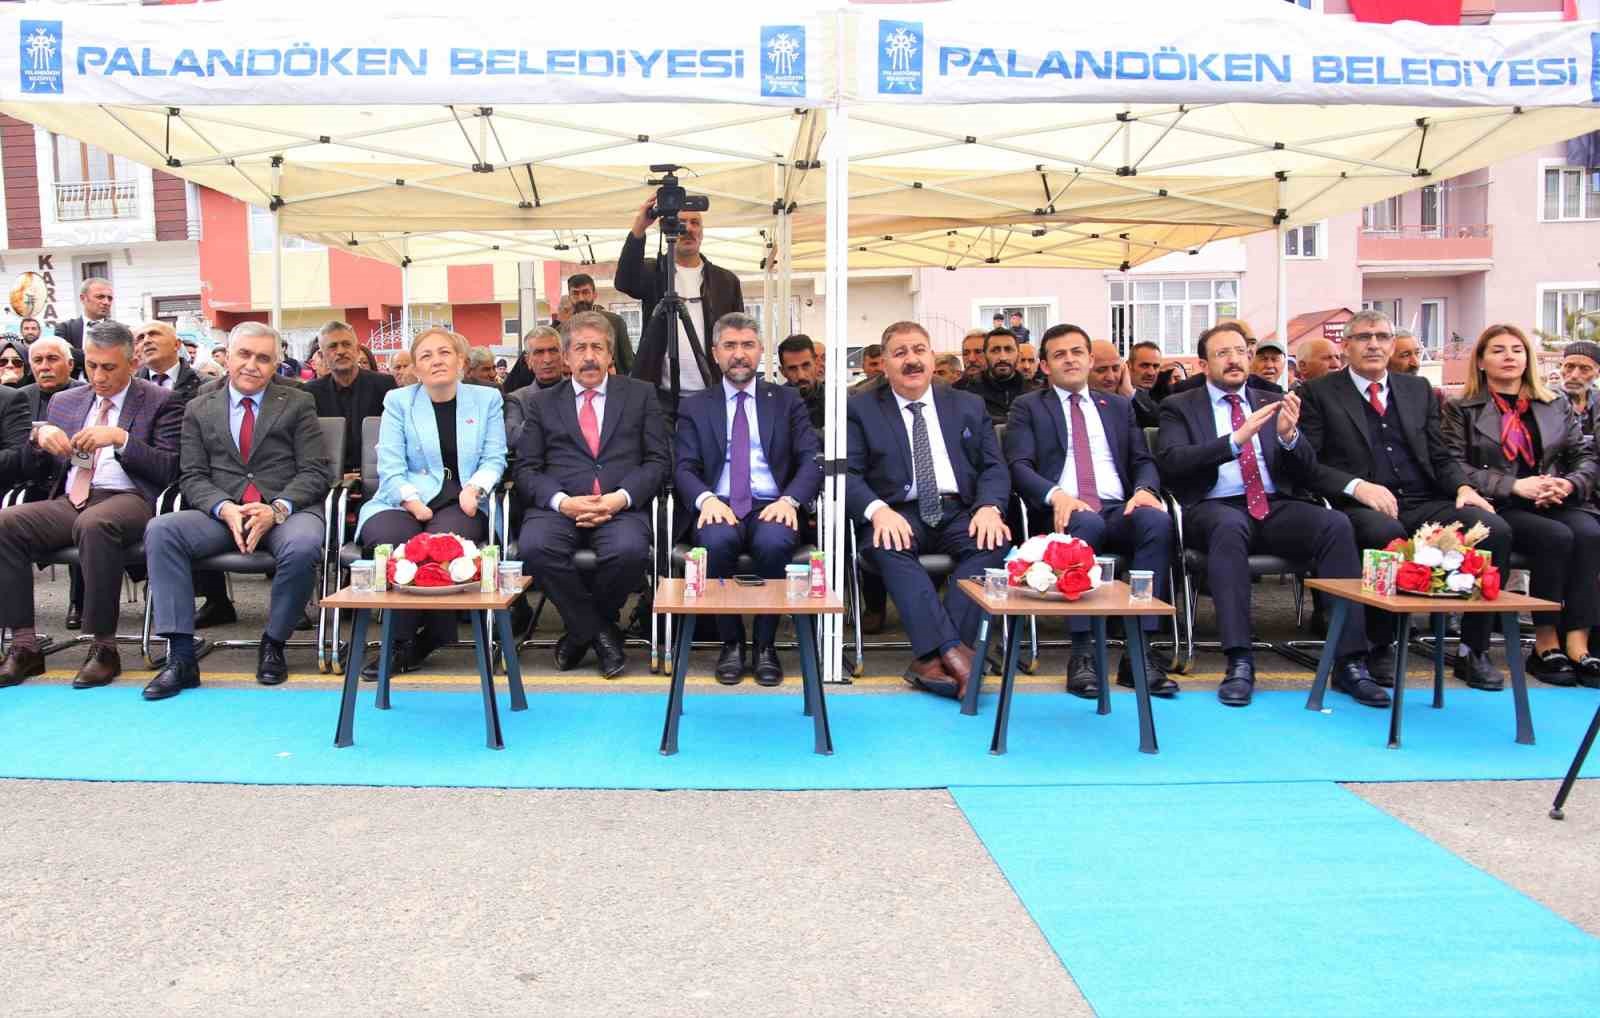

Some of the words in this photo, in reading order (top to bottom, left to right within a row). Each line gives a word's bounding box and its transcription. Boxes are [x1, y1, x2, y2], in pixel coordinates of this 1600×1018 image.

[76, 41, 428, 77] PALANDÖKEN
[938, 45, 1292, 81] PALANDÖKEN
[38, 254, 58, 328] KARA
